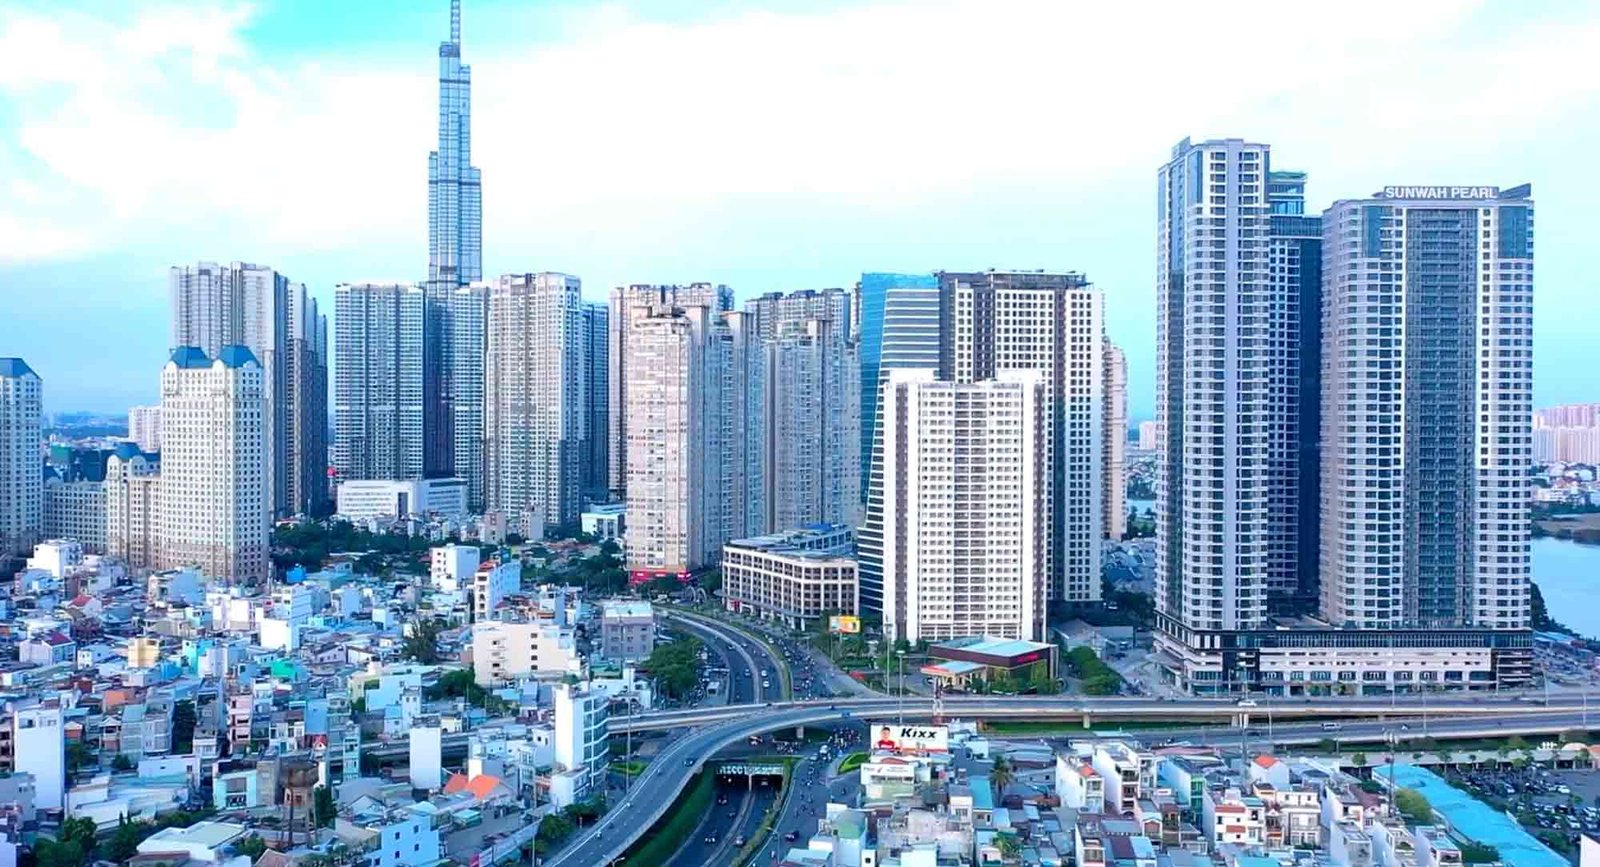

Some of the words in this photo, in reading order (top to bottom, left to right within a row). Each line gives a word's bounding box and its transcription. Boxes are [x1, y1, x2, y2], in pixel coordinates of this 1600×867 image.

[1385, 187, 1447, 199] SUNWAH
[1451, 187, 1498, 199] PEARL
[901, 727, 937, 738] Kixx
